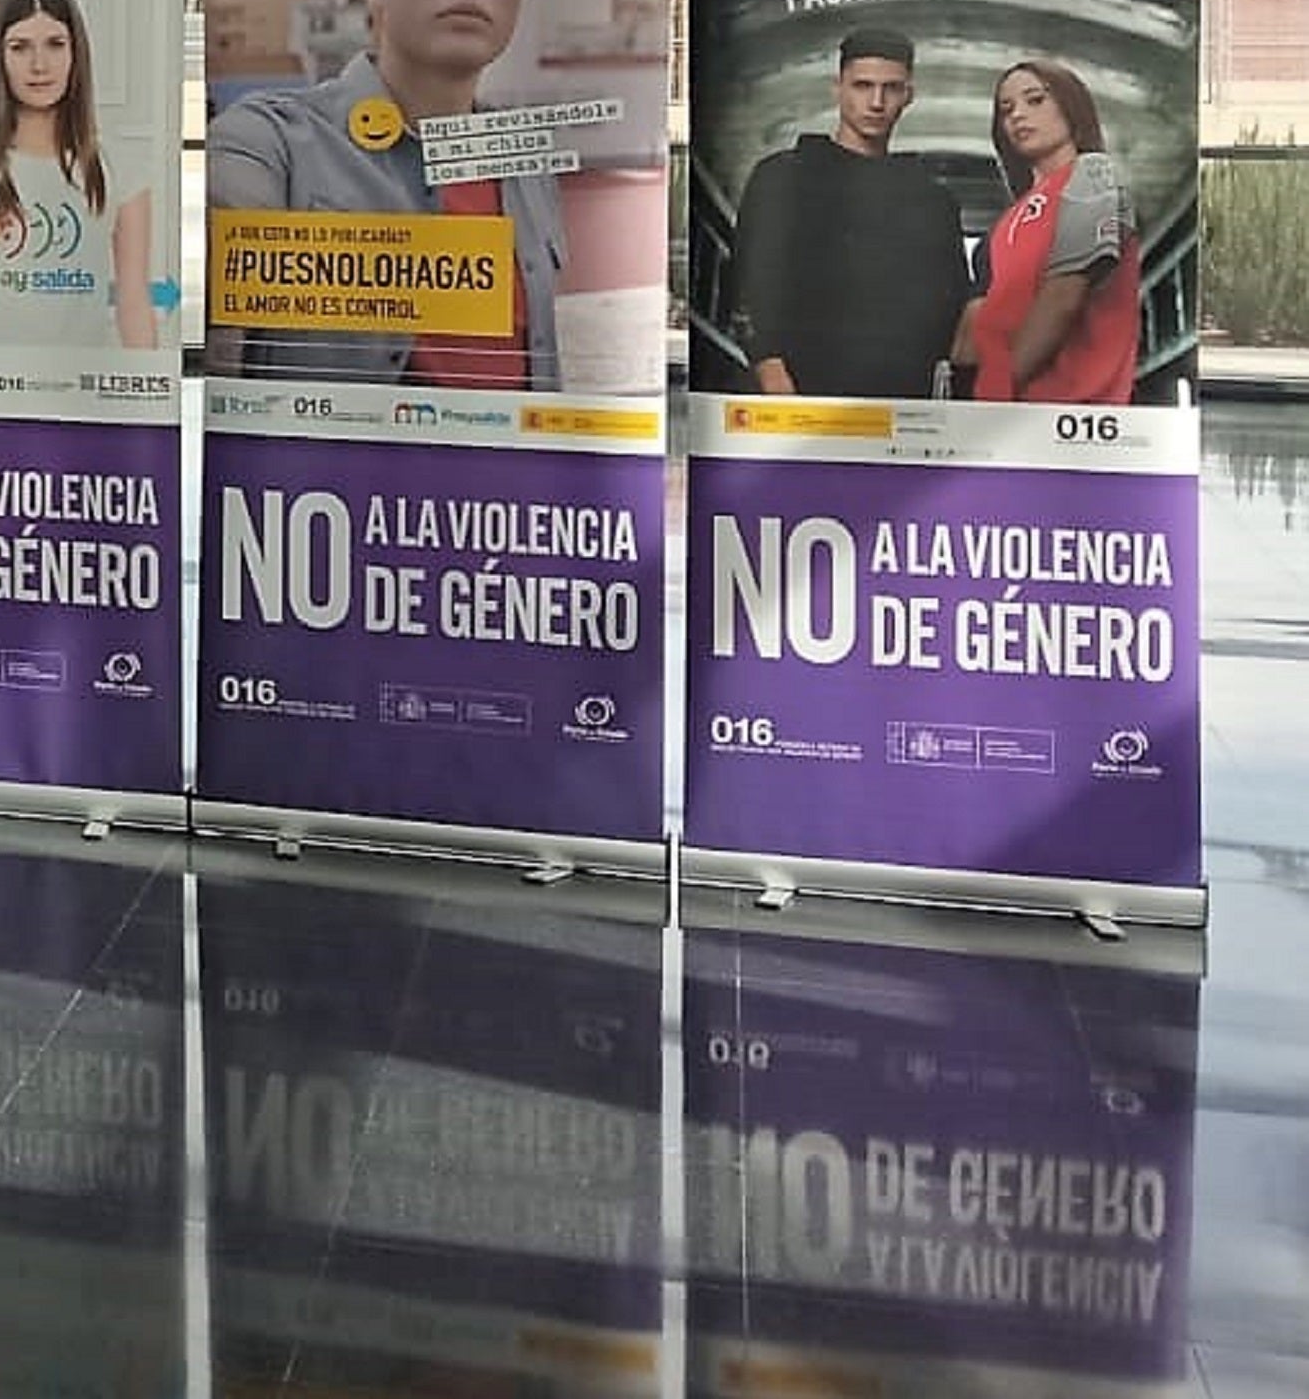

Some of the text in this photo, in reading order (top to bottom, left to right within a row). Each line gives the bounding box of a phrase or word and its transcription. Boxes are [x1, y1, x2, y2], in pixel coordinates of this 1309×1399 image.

[451, 134, 548, 156] mi chica
[476, 157, 575, 178] mensajes
[31, 267, 95, 291] salida
[224, 249, 495, 291] #PUESNOLOHAGAS
[224, 293, 240, 313] EL
[245, 294, 290, 314] AMOR
[294, 295, 317, 315] NO
[322, 296, 342, 316] ES
[294, 398, 332, 416] 016
[1056, 414, 1120, 441] 016
[365, 495, 638, 562] A LA VIOLENCIA
[222, 485, 352, 630] NO
[871, 521, 1173, 588] A LA VIOLENCIA
[365, 557, 639, 652] DE GÉNERO
[712, 514, 857, 666] NO
[871, 585, 1174, 683] DE GÉNERO
[221, 675, 278, 705] 016
[710, 714, 775, 747] 016
